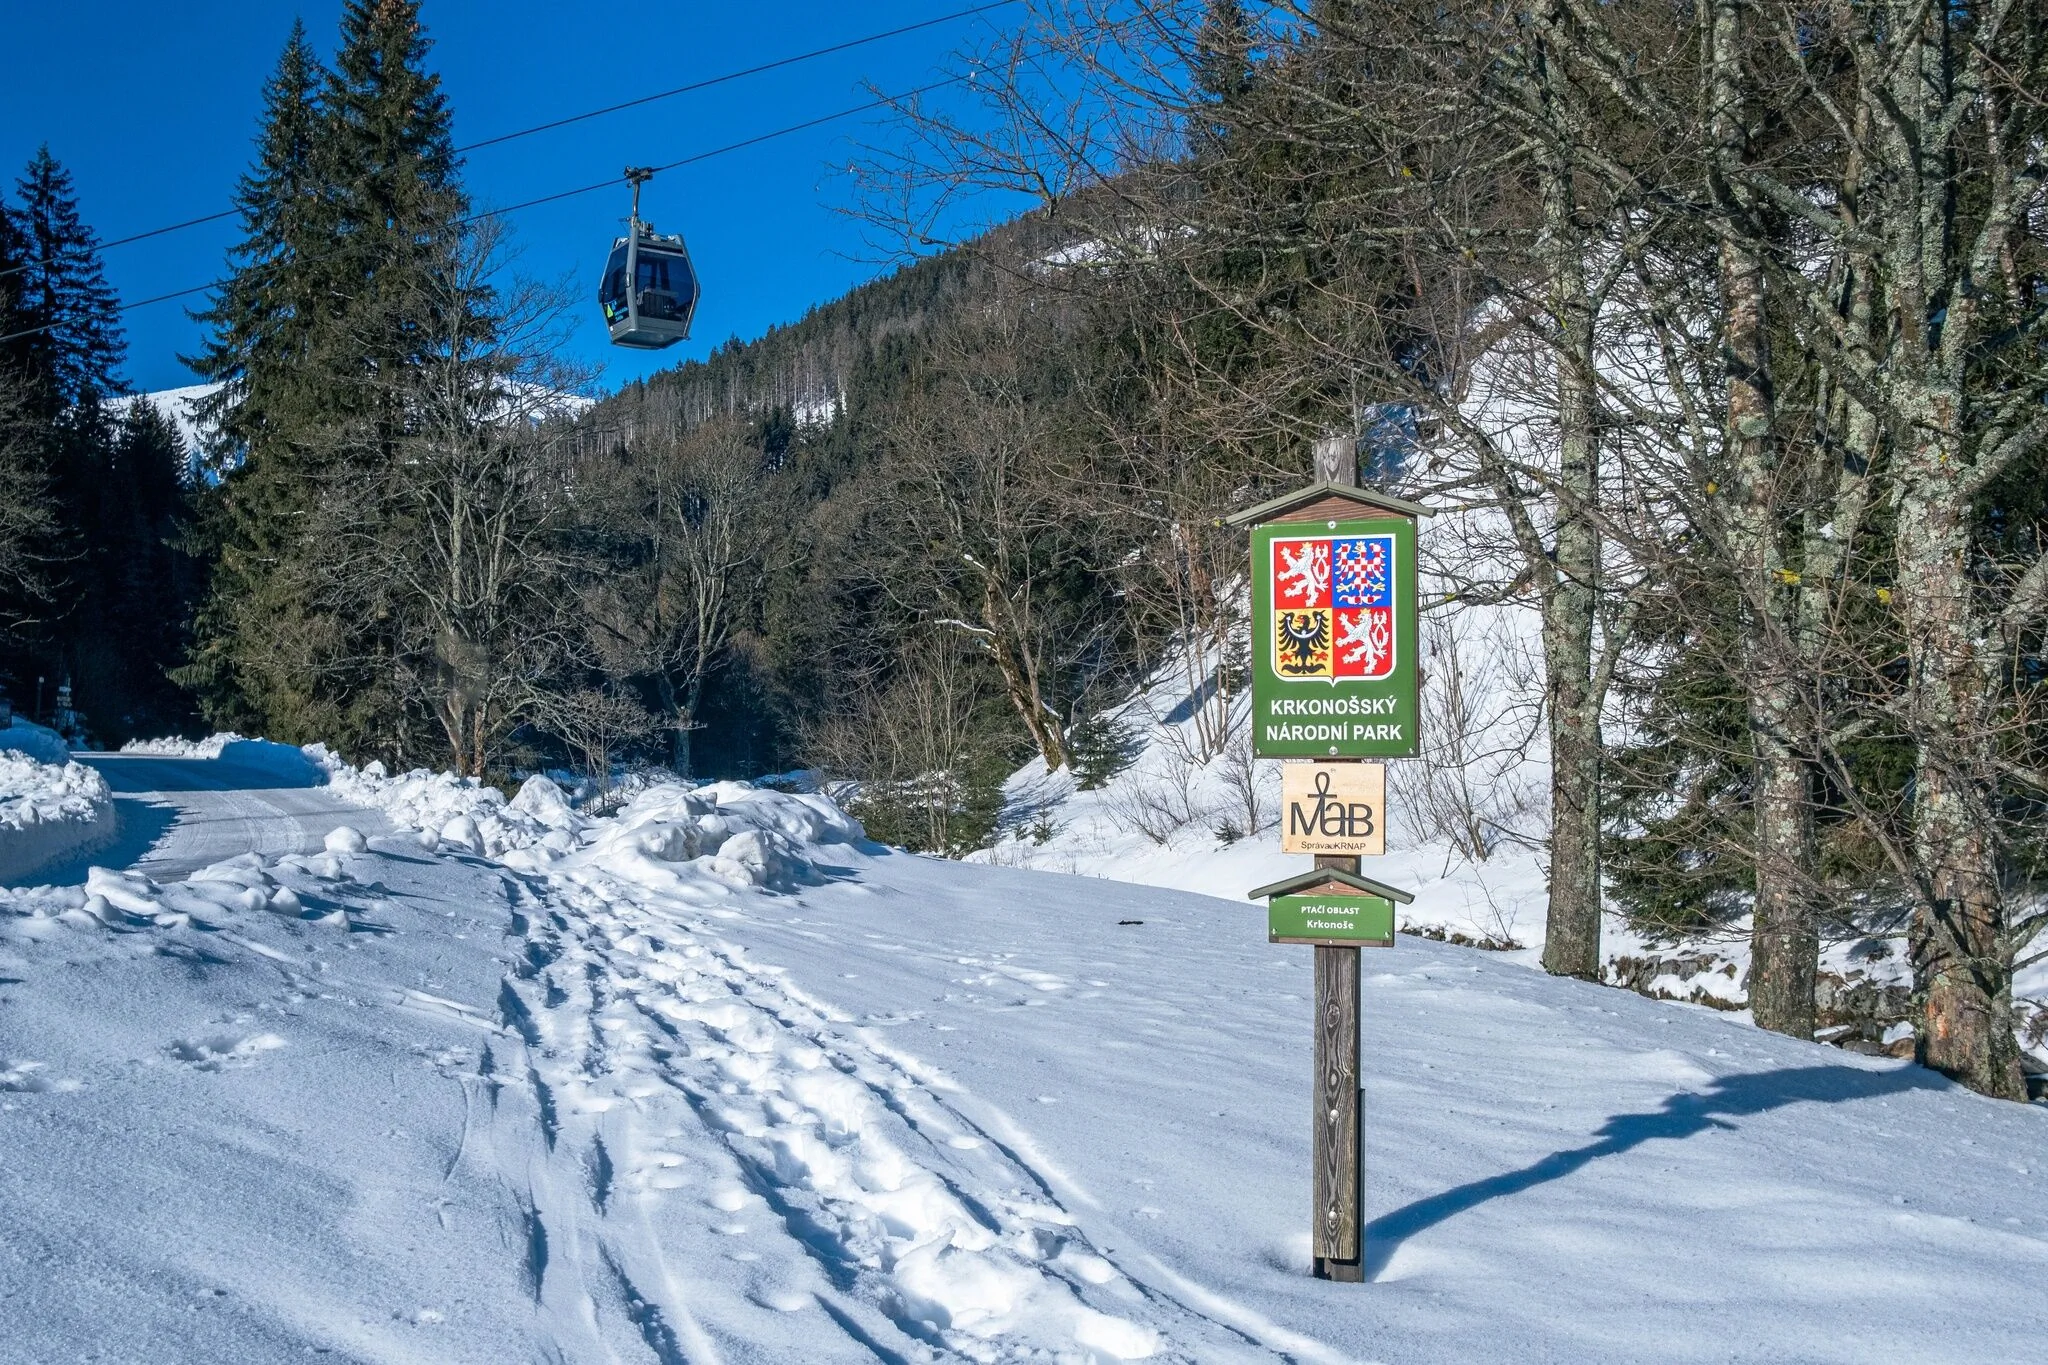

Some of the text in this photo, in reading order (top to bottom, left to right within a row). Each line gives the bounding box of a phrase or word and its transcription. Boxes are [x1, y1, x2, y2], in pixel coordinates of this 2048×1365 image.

[1271, 695, 1397, 715] KRKONOŠSKÝ
[1266, 722, 1402, 741] NÁRODNÍ PARK
[1300, 840, 1366, 850] Správa KRNAP
[1301, 905, 1360, 915] PTAČÍ OBLAST
[1306, 919, 1354, 929] Krkonoše
